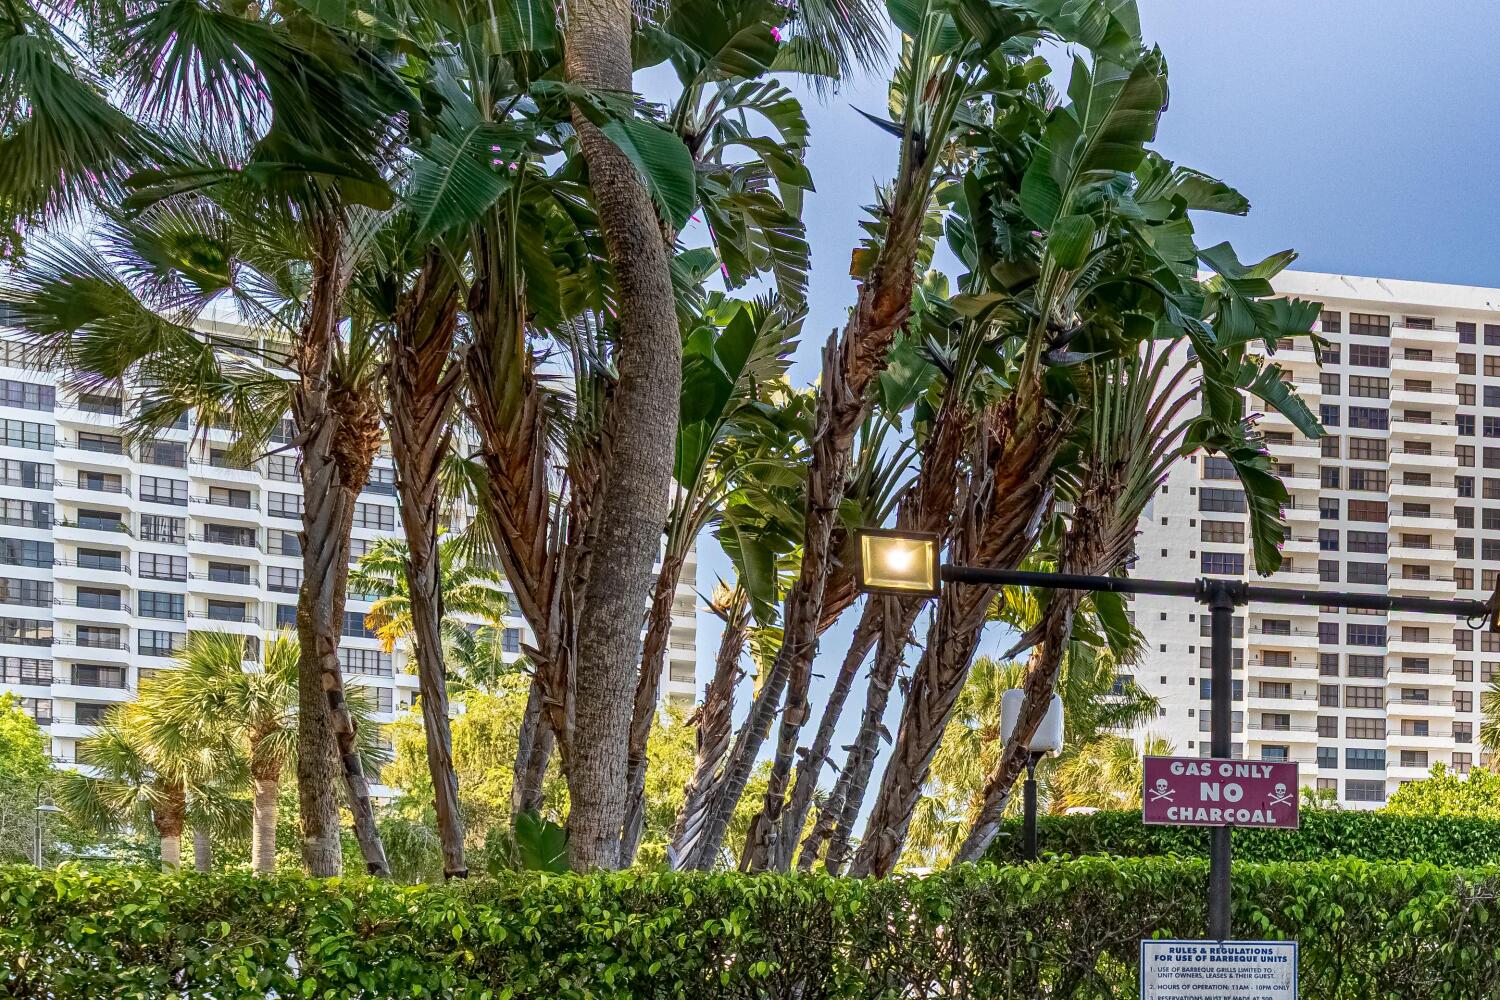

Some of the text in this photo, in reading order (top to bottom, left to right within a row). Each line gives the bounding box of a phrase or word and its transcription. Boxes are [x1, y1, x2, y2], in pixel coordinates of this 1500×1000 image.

[1170, 762, 1274, 778] GAS ONLY
[1200, 782, 1244, 802] NO
[1167, 806, 1276, 823] CHARCOAL
